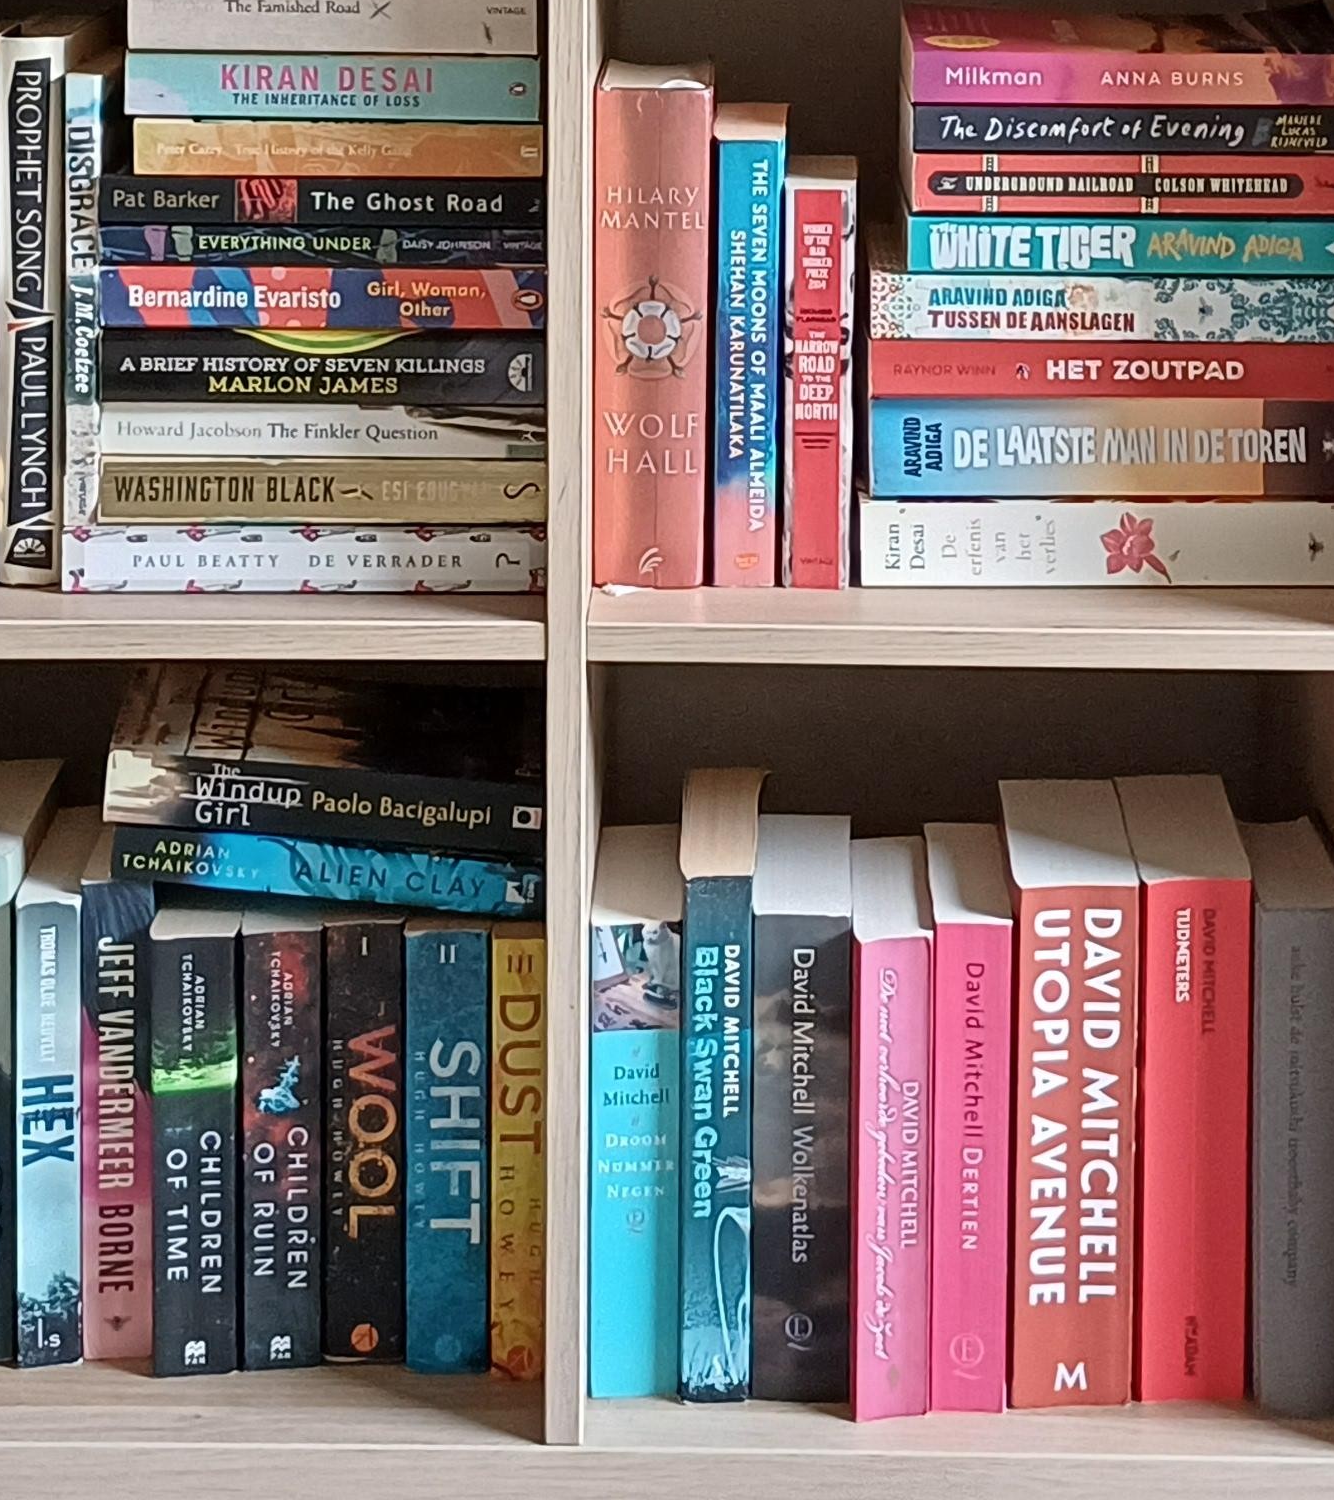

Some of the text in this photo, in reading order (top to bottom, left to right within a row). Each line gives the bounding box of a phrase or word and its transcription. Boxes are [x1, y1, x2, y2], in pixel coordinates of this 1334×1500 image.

[224, 0, 361, 14] The Famished Road
[221, 64, 434, 92] KIRAN DESAI
[945, 68, 1244, 86] Milkman ANNA BURNS
[14, 70, 44, 293] PROPHET SONG
[113, 190, 219, 210] Pat Barker
[311, 192, 503, 213] The Ghost Road
[606, 188, 699, 205] HILARY
[600, 211, 705, 230] MANTEL
[128, 285, 341, 309] Bernardine Evaristo
[367, 281, 486, 300] Girl, Woman,
[399, 302, 451, 317] Other
[748, 160, 769, 532] THE SEVEN MOONS OF MAALI ALMEIDA
[1046, 360, 1244, 380] HET ZOUTPAD
[208, 377, 398, 394] MARLON JAMES
[20, 337, 48, 506] PAUL LYNCH
[604, 412, 699, 438] WOLF
[607, 449, 699, 475] HALL
[133, 554, 463, 568] PAUL BEATTY DE VERRADER
[498, 994, 541, 1155] DUST
[97, 937, 135, 1295] JEFF VANDERMEER BORNE
[1028, 910, 1071, 1307] UTOPIA AVENUE
[1077, 908, 1123, 1304] DAVID MITCHELL
[348, 1025, 398, 1239] WOOL
[429, 1040, 481, 1244] SHIFT
[166, 1149, 188, 1281] OF TIME
[200, 1131, 222, 1293] CHILDREN
